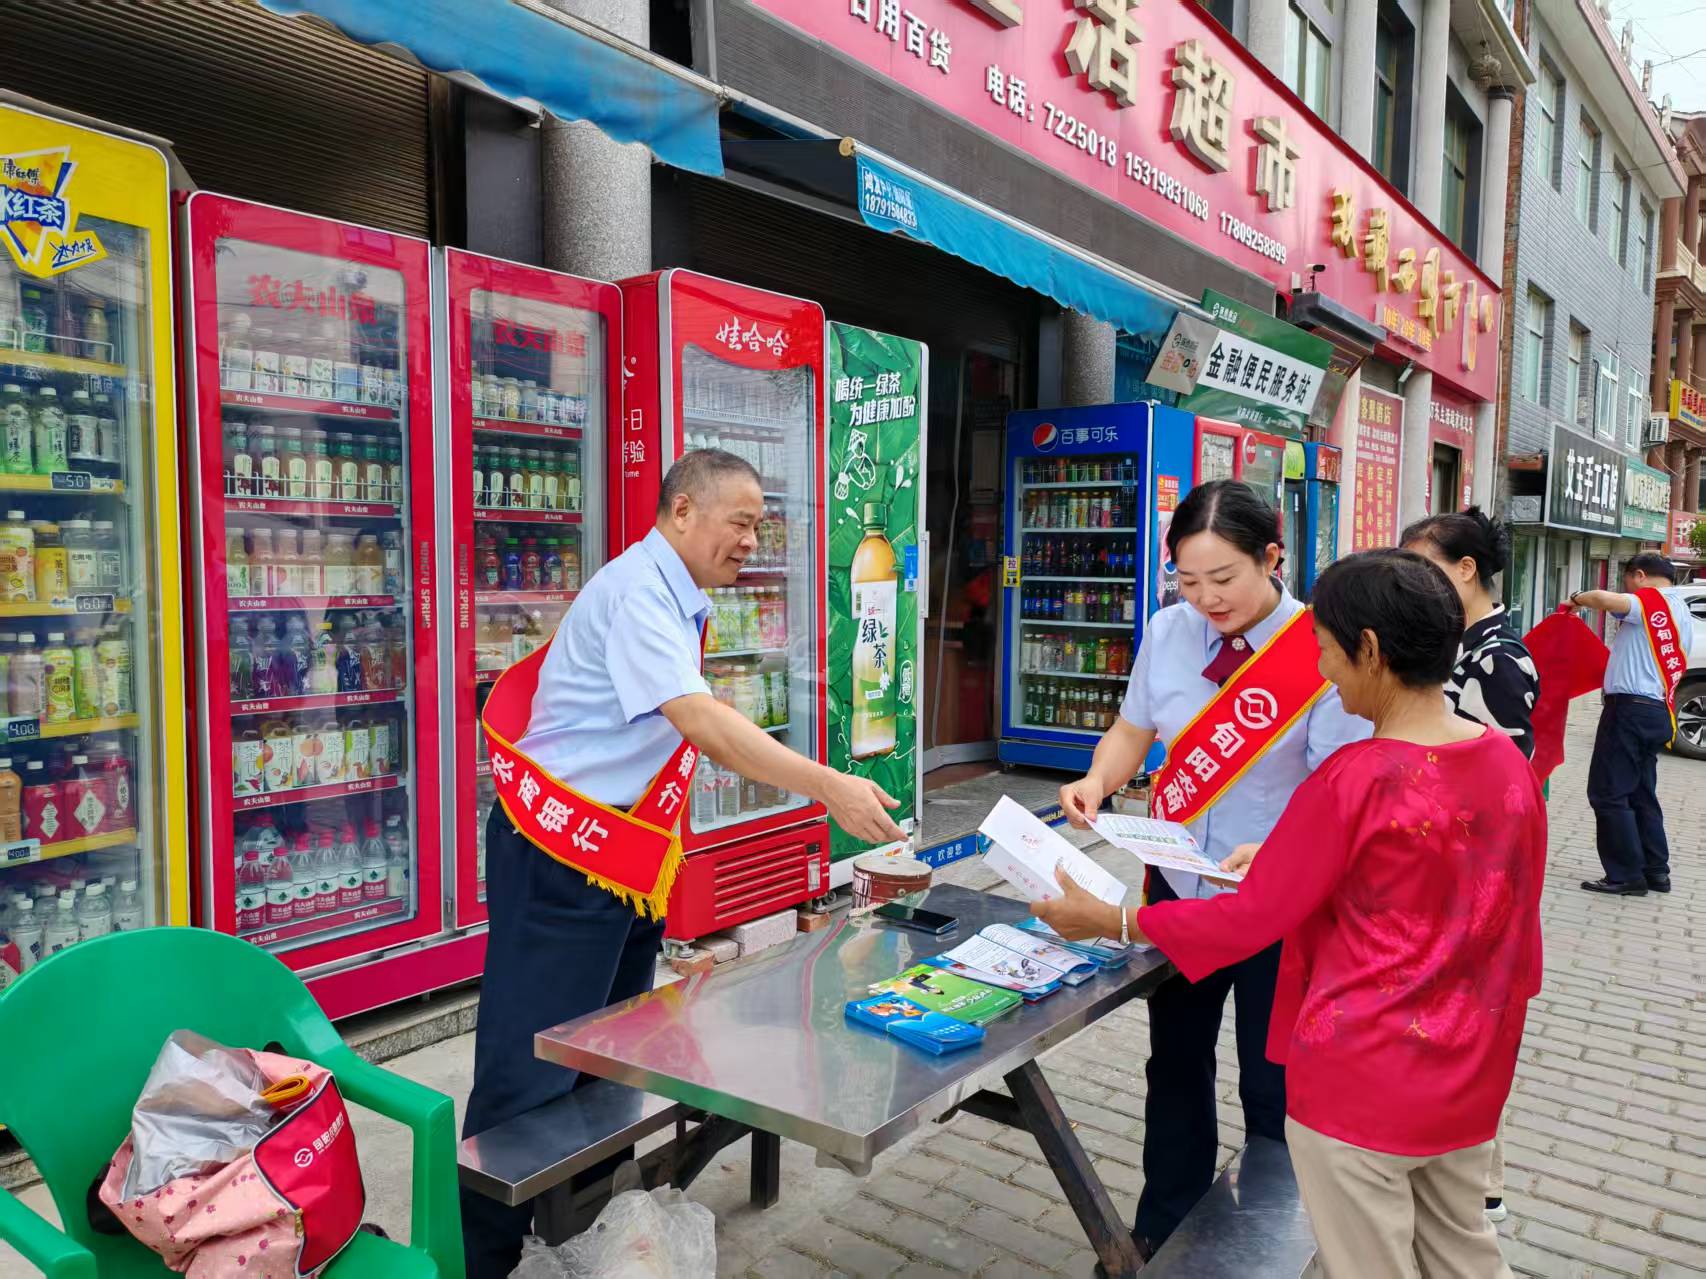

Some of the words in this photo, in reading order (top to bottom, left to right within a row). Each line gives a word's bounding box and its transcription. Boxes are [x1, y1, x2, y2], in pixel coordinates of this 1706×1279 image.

[1044, 101, 1117, 167] 7225018
[1125, 152, 1209, 221] 15319831068
[1220, 211, 1287, 265] 17809258899
[248, 274, 377, 325] 农夫山泉
[492, 318, 586, 358] 农夫山泉
[715, 316, 788, 357] 娃哈哈
[835, 371, 901, 403] 喝统一绿茶
[1206, 342, 1312, 405] 金融便民服务站
[624, 408, 642, 431] 日
[849, 395, 916, 427] 为健康加酚
[1060, 426, 1118, 445] 百事可乐
[460, 590, 469, 629] SPRING
[862, 618, 887, 669] 绿茶
[1657, 629, 1683, 703] 旬阳农商
[492, 752, 608, 852] 农商银行
